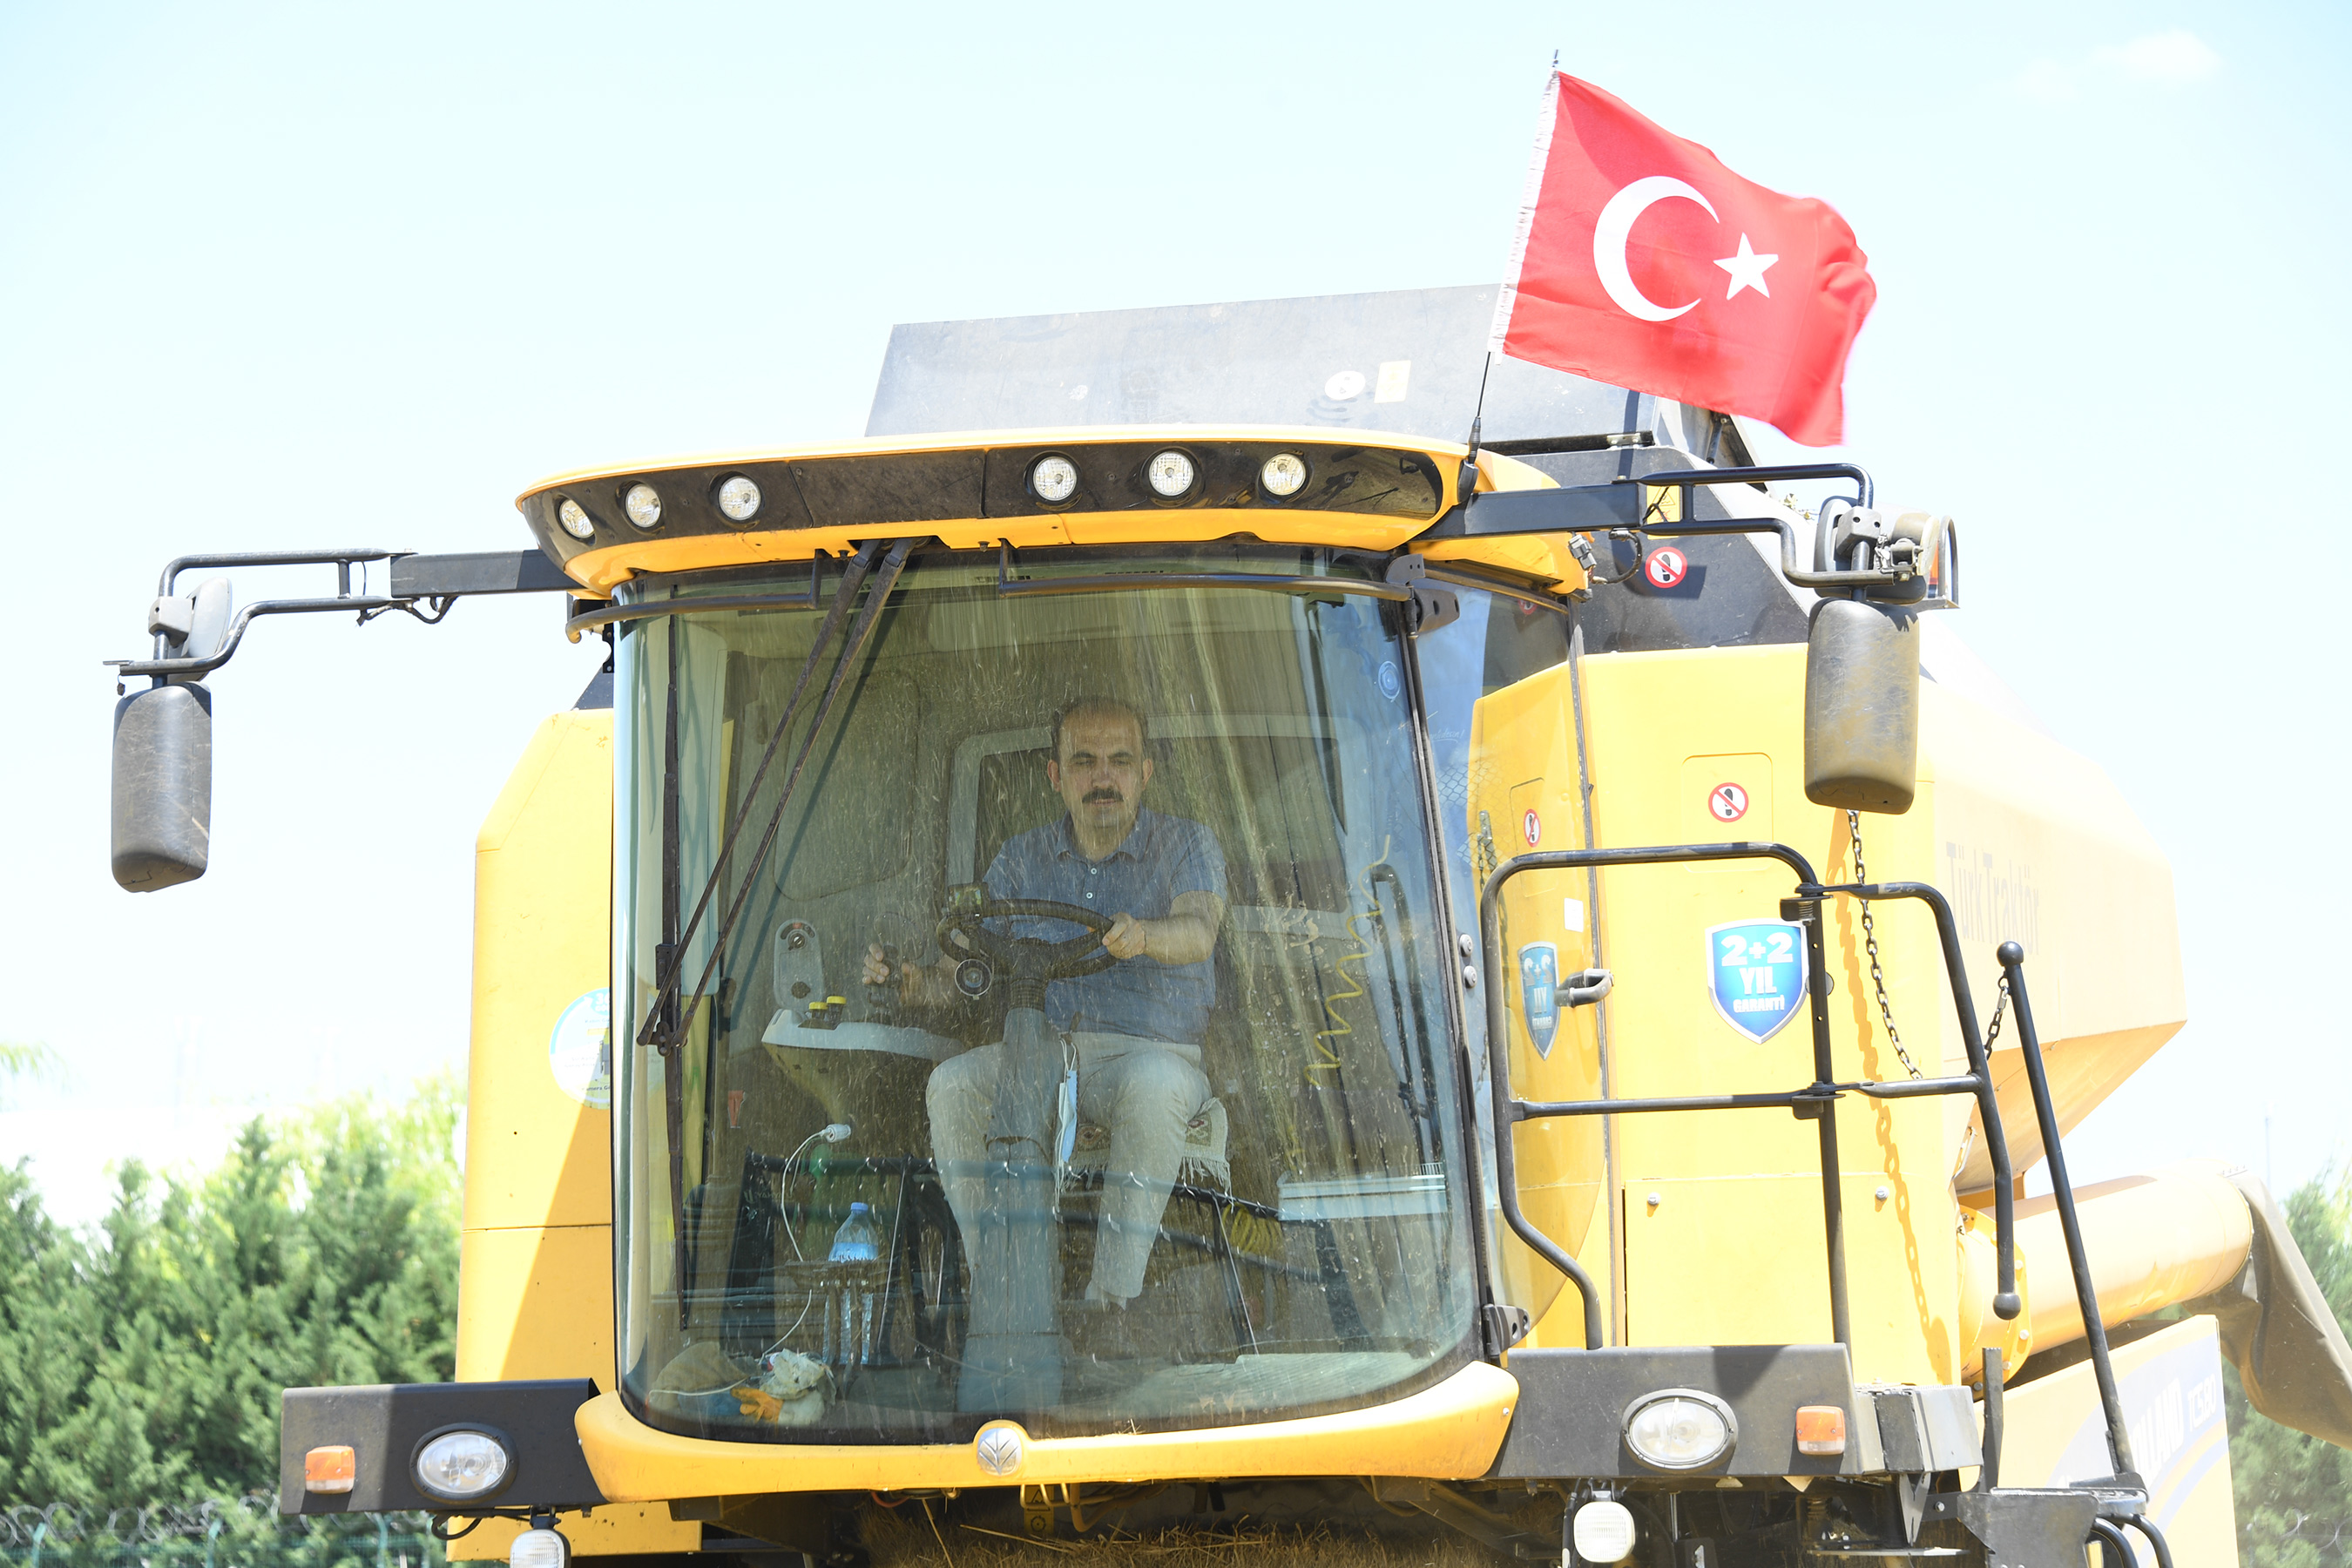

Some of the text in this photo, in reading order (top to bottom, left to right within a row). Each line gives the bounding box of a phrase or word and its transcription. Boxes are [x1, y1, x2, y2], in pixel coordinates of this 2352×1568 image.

[1720, 931, 1794, 967] 2+2
[1739, 966, 1778, 996] YIL
[1733, 994, 1786, 1013] GARANTİ
[2128, 1377, 2184, 1490] OLLAND
